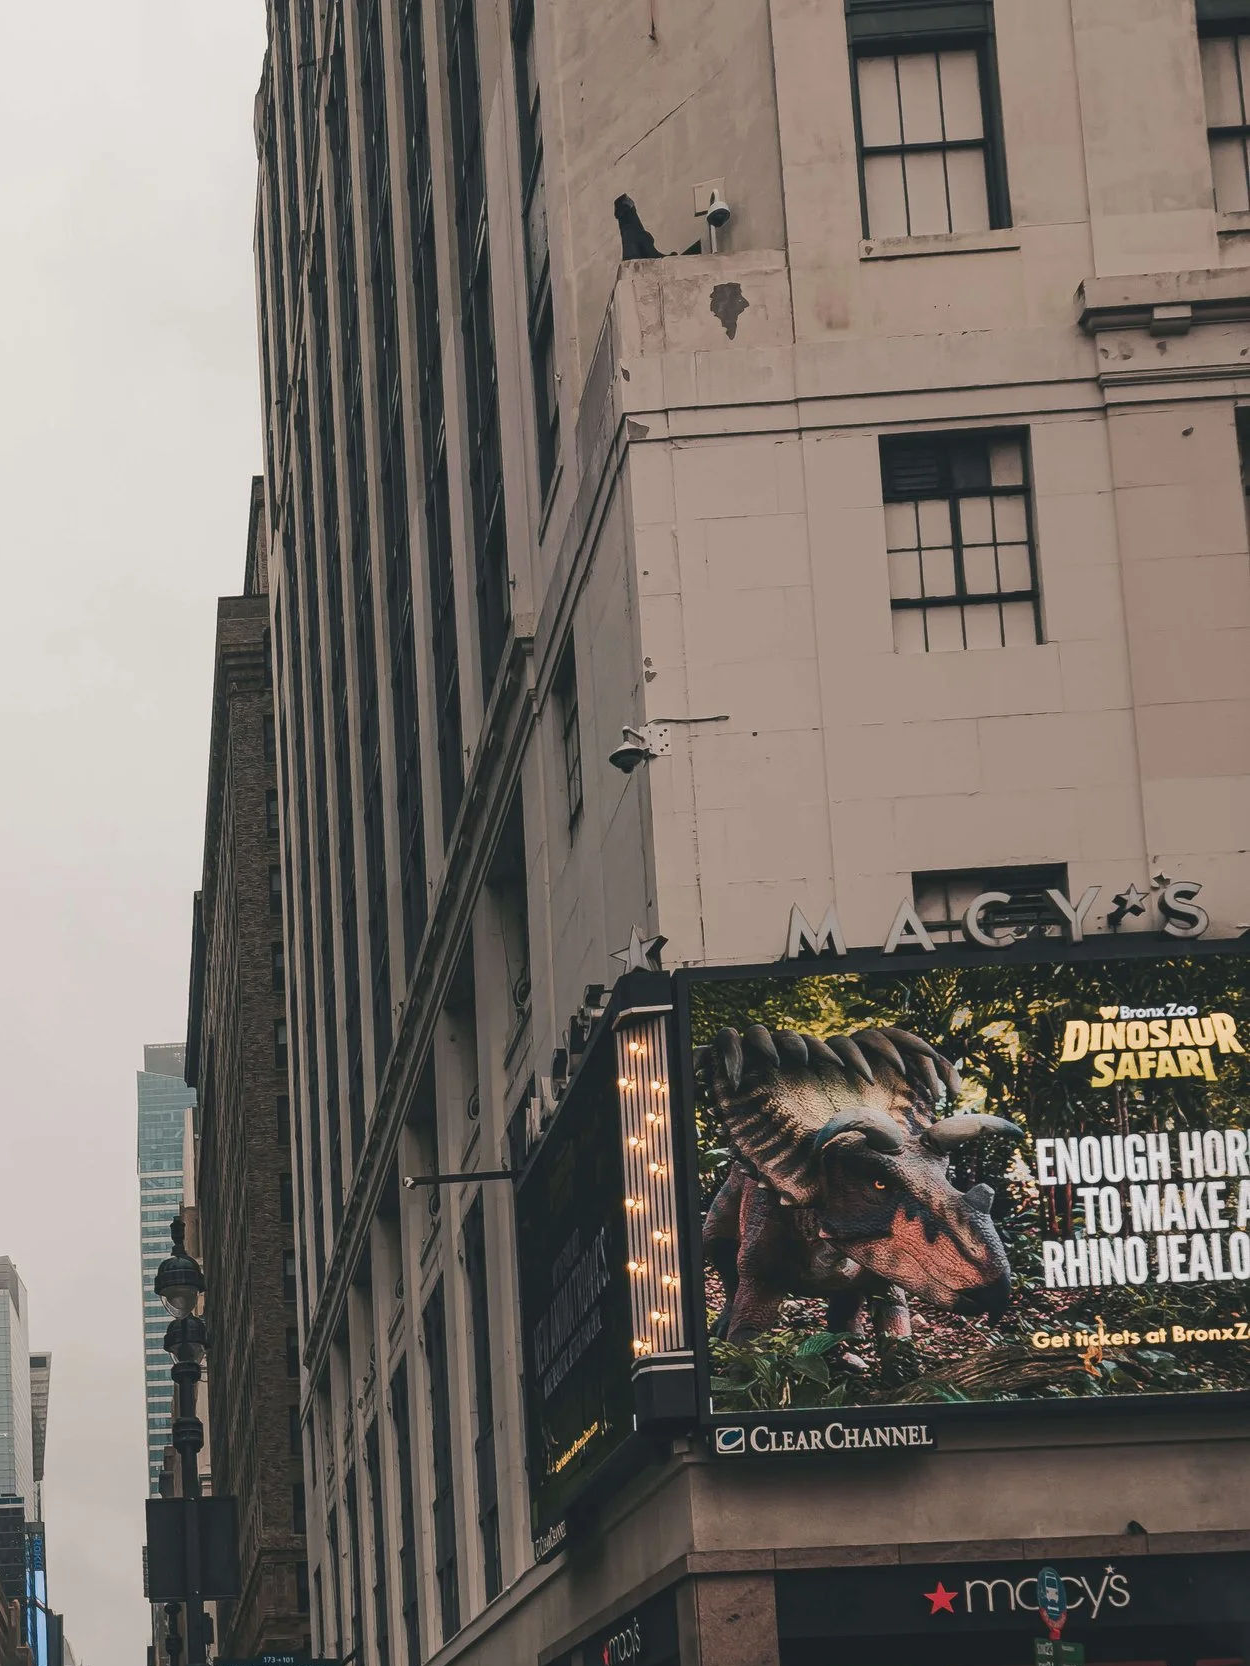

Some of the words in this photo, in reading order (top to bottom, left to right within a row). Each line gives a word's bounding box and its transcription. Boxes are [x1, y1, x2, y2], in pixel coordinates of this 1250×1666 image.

[785, 880, 1210, 961] MACY'S
[1060, 1012, 1245, 1063] DINOSAUR
[1091, 1048, 1218, 1088] SAFARI
[1036, 1132, 1171, 1186] ENOUGH
[1179, 1129, 1250, 1179] HOR
[1077, 1186, 1124, 1235] TO
[1130, 1181, 1230, 1233] MAKE
[1042, 1236, 1149, 1288] RHINO
[1032, 1332, 1071, 1349] Get
[1074, 1326, 1141, 1348] tickets
[1146, 1328, 1167, 1344] at
[263, 1656, 276, 1664] 173
[283, 1656, 295, 1664] 101
